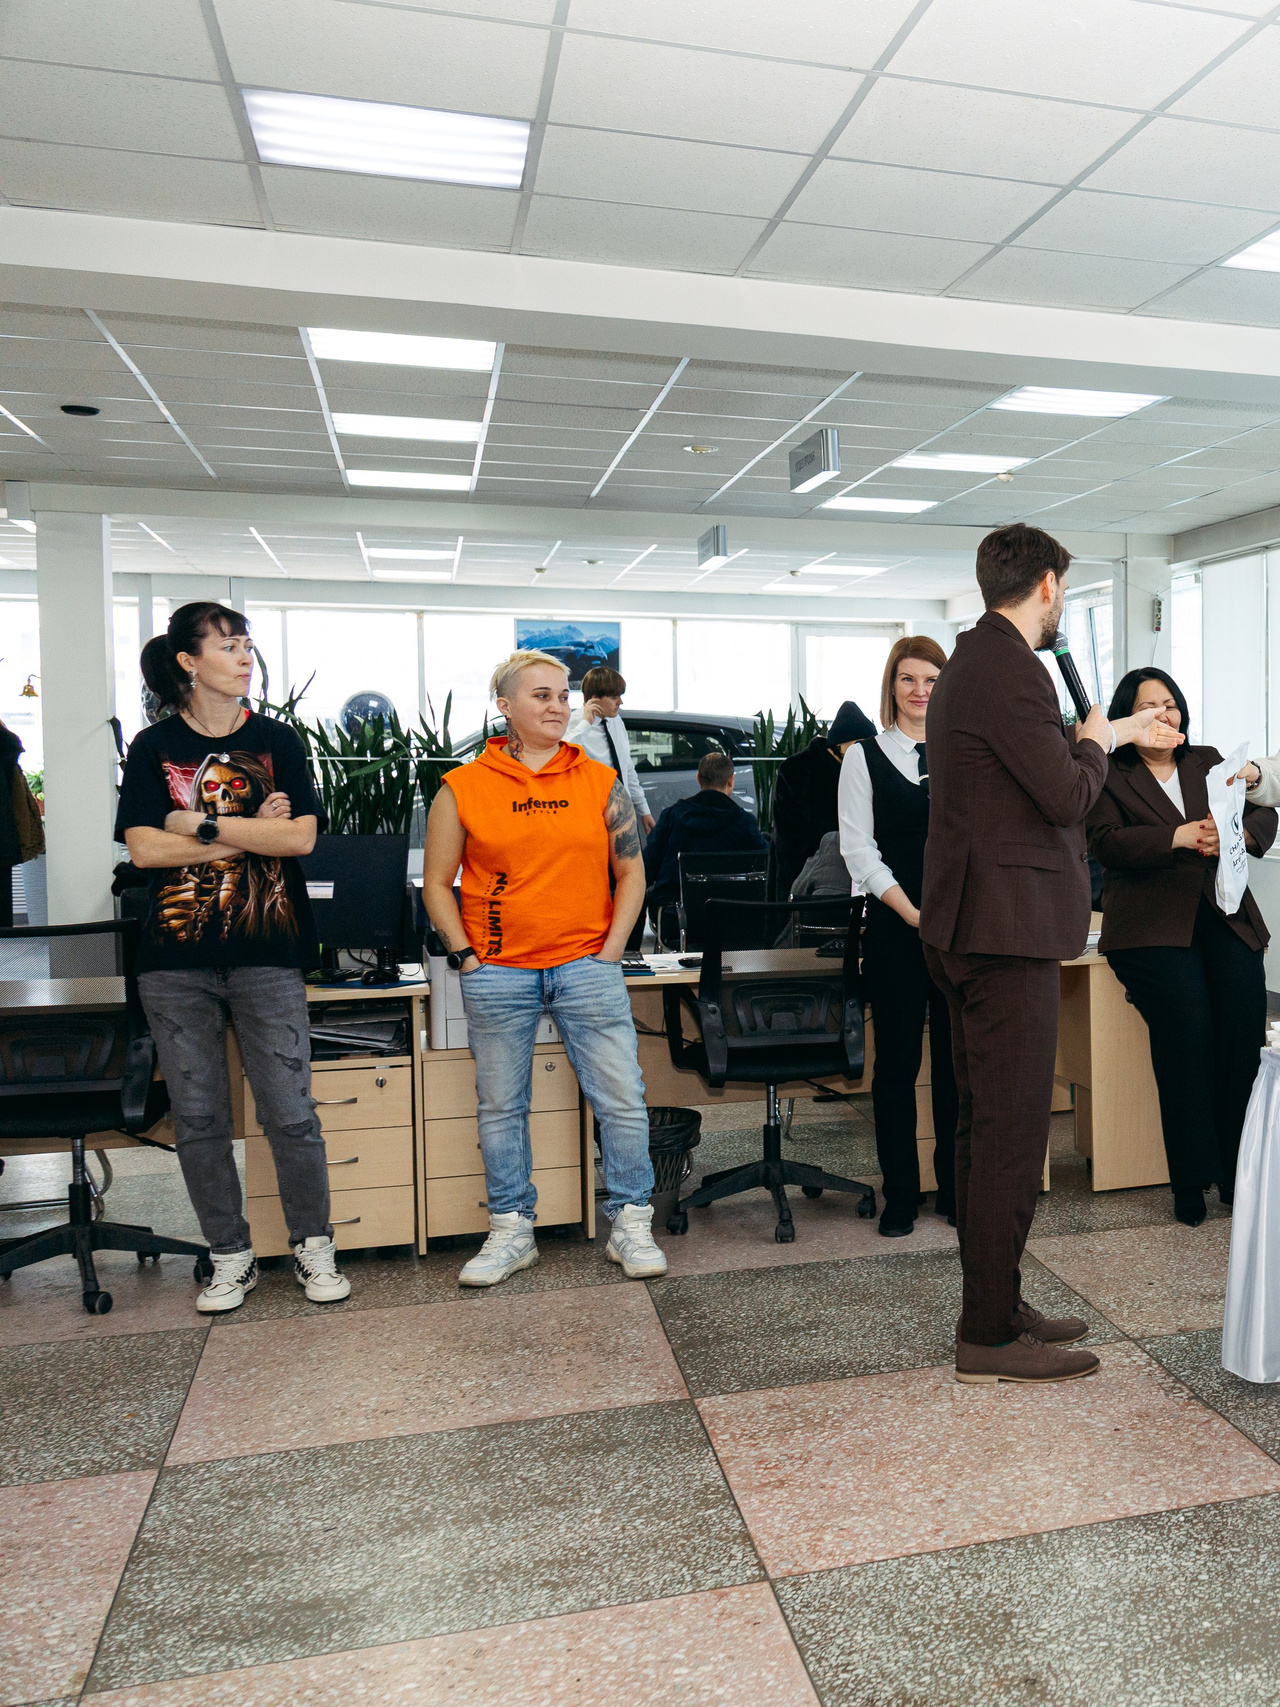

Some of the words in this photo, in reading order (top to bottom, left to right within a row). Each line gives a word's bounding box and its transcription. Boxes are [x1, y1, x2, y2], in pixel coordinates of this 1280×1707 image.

[512, 797, 569, 813] Inferno
[491, 872, 508, 897] NO
[486, 901, 504, 957] LIMITS
